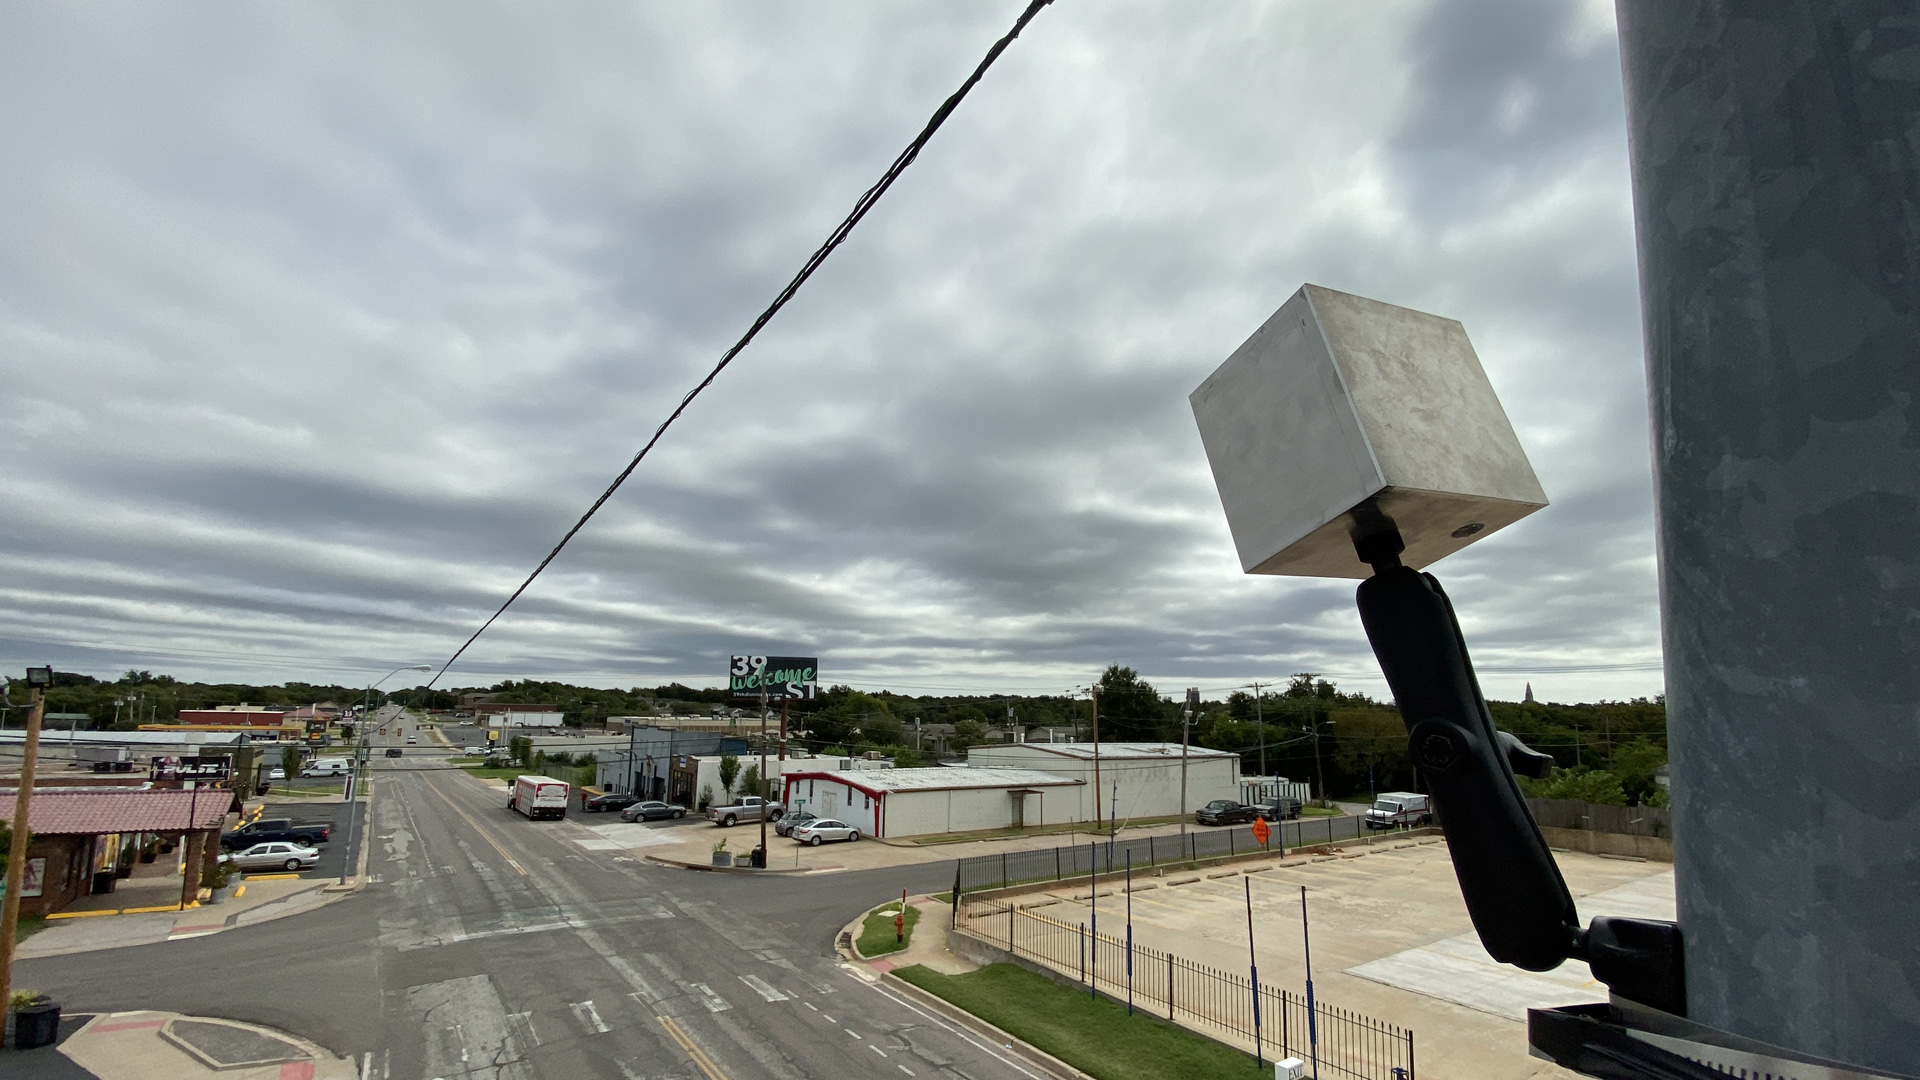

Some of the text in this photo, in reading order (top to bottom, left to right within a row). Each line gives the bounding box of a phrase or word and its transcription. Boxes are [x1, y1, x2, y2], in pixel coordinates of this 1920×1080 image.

[732, 656, 767, 676] 39
[731, 664, 816, 691] welcome
[785, 680, 816, 699] ST
[163, 764, 219, 774] PULSE
[1289, 1063, 1304, 1080] EXIT
